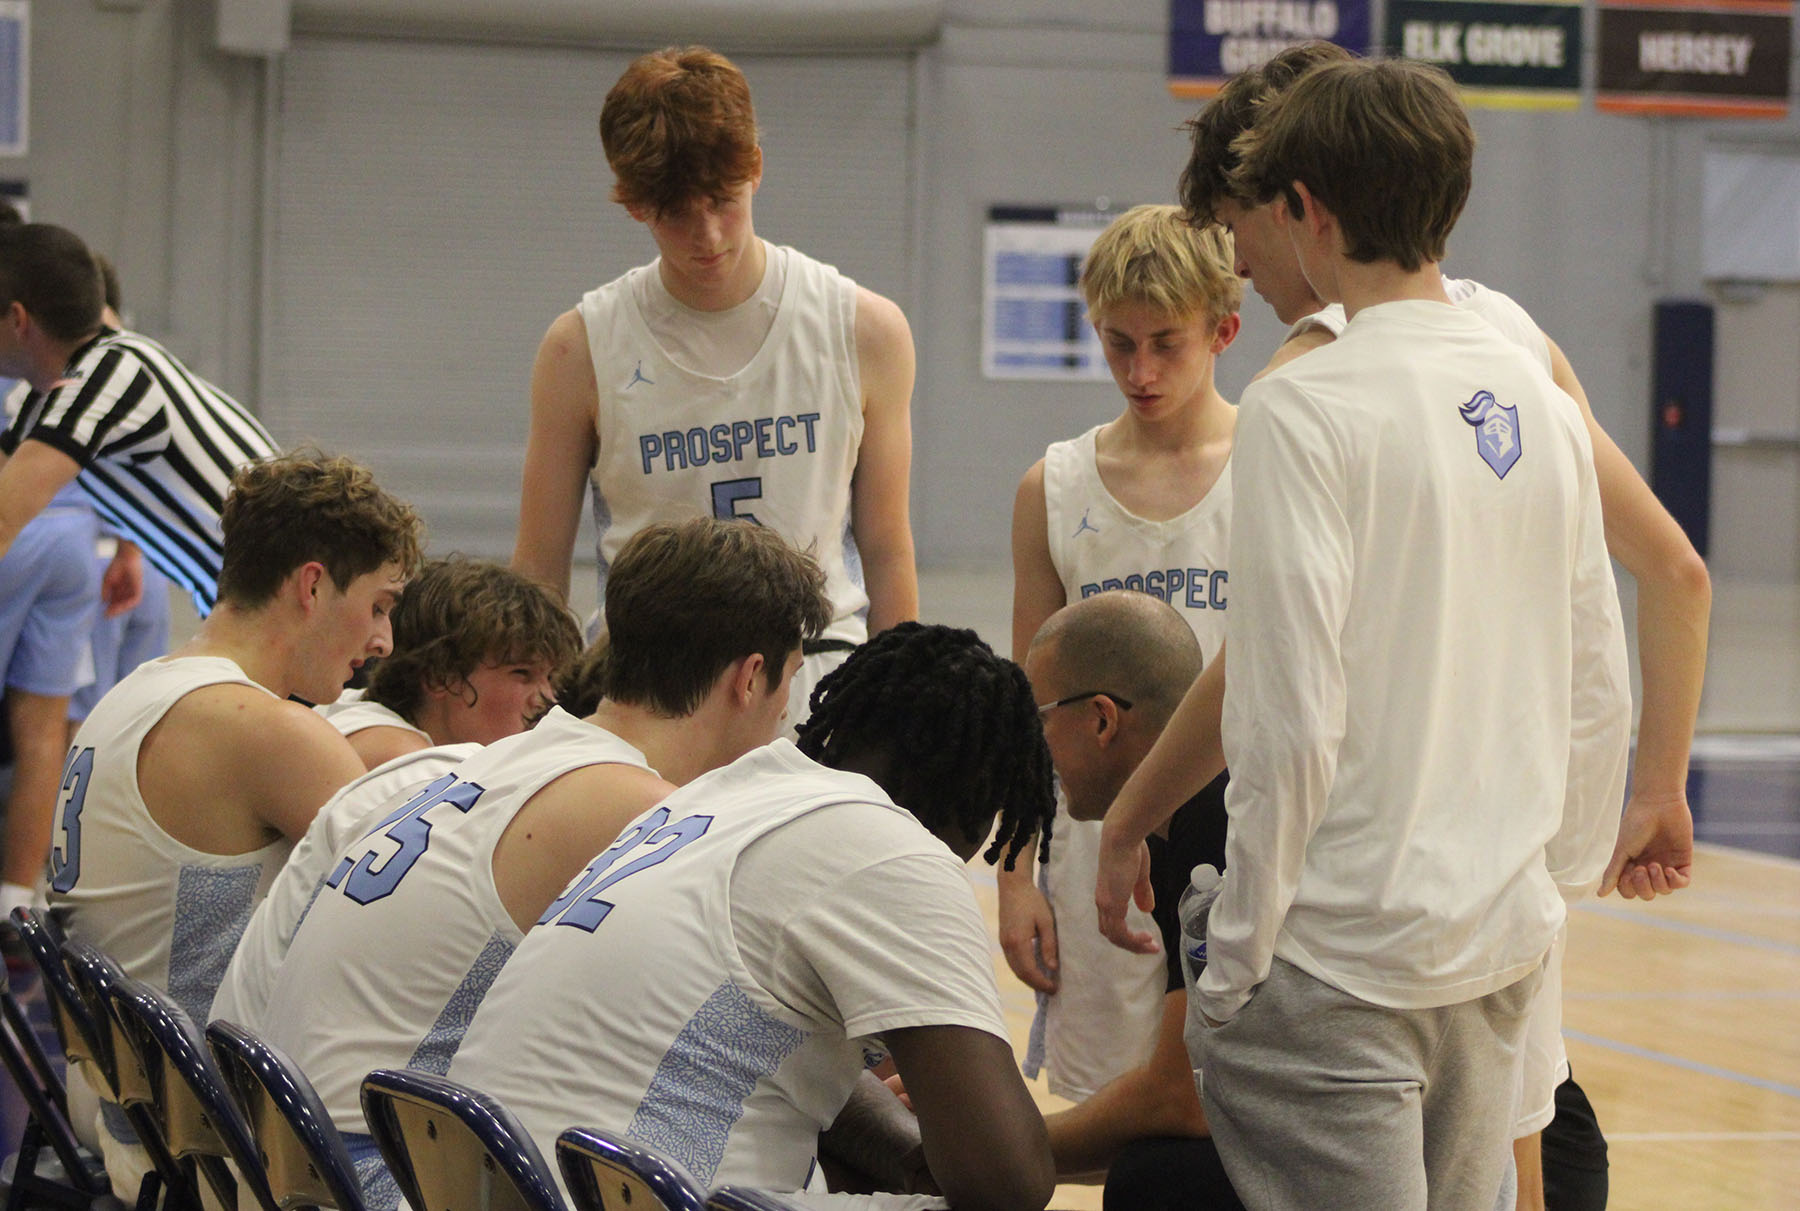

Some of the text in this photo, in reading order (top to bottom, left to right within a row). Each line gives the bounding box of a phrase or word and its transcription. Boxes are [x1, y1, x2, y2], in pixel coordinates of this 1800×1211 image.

[1403, 21, 1565, 67] ELK GROVE
[1639, 32, 1754, 75] HERSEY
[640, 413, 820, 474] PROSPECT
